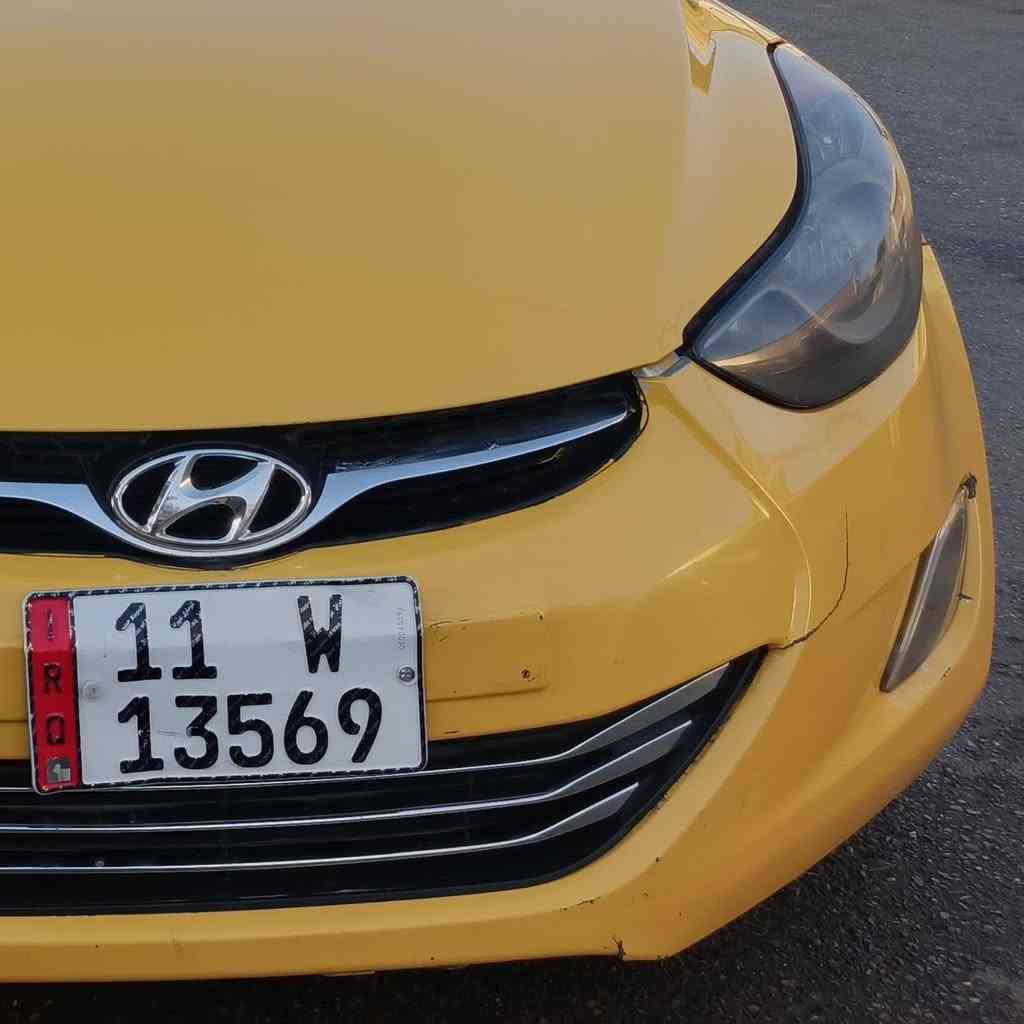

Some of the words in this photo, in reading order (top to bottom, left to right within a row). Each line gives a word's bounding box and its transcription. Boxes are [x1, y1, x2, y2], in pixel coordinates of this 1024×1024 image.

[115, 599, 218, 683] 11
[296, 593, 344, 674] W
[117, 687, 383, 774] 13569
